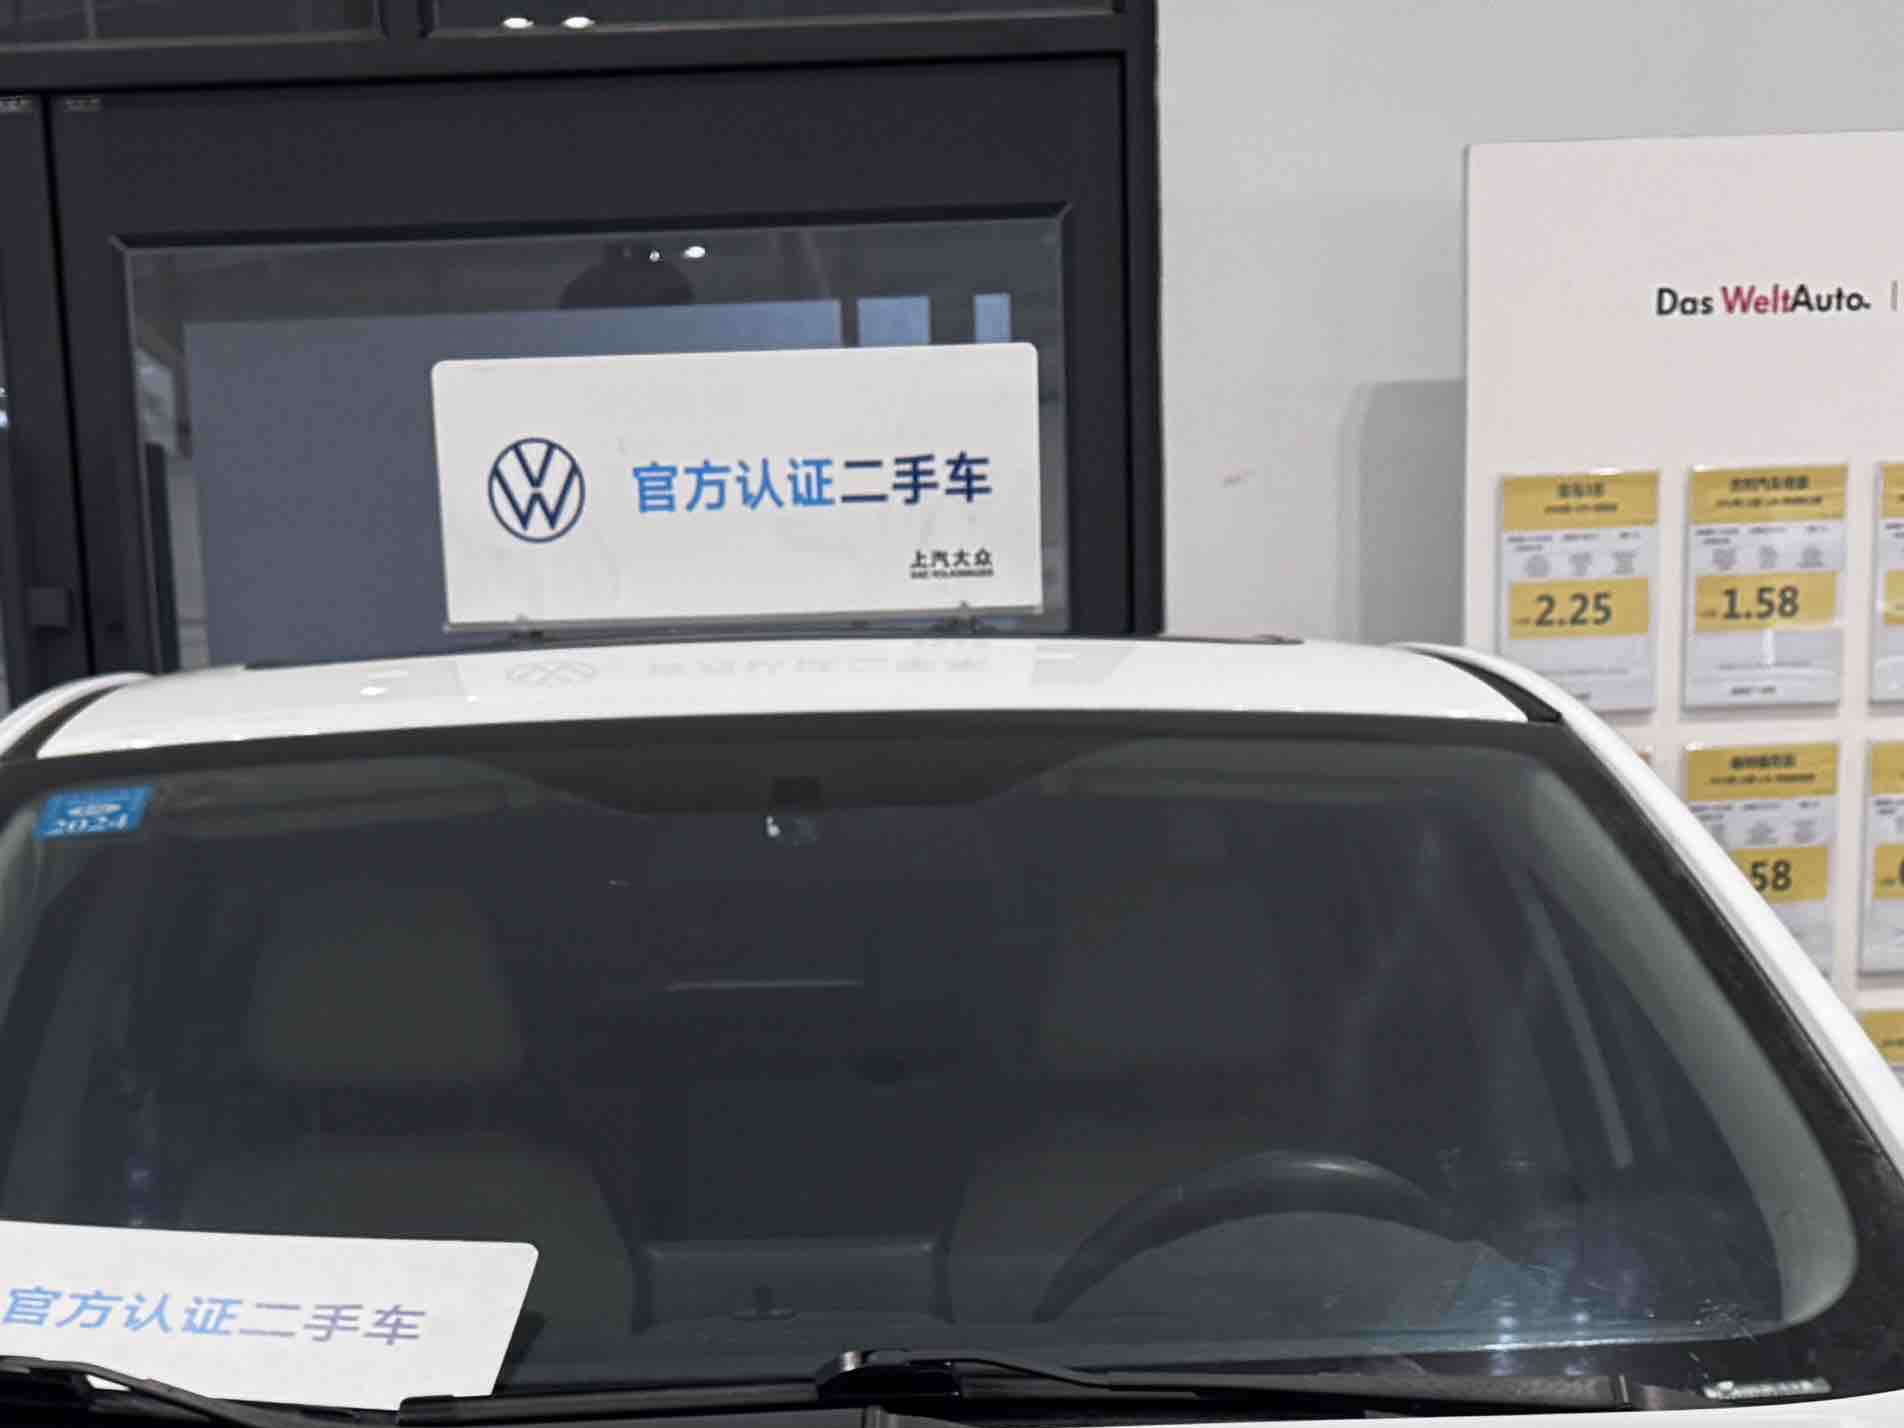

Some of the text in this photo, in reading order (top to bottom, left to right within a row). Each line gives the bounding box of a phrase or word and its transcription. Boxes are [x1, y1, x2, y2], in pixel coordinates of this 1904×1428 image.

[1656, 287, 1713, 316] Das
[631, 450, 993, 514] 官方认证二手车
[1535, 591, 1613, 628] 2.25
[1723, 585, 1799, 621] 1.58
[1749, 859, 1792, 893] 58
[0, 1284, 428, 1348] 官方认证二手车
